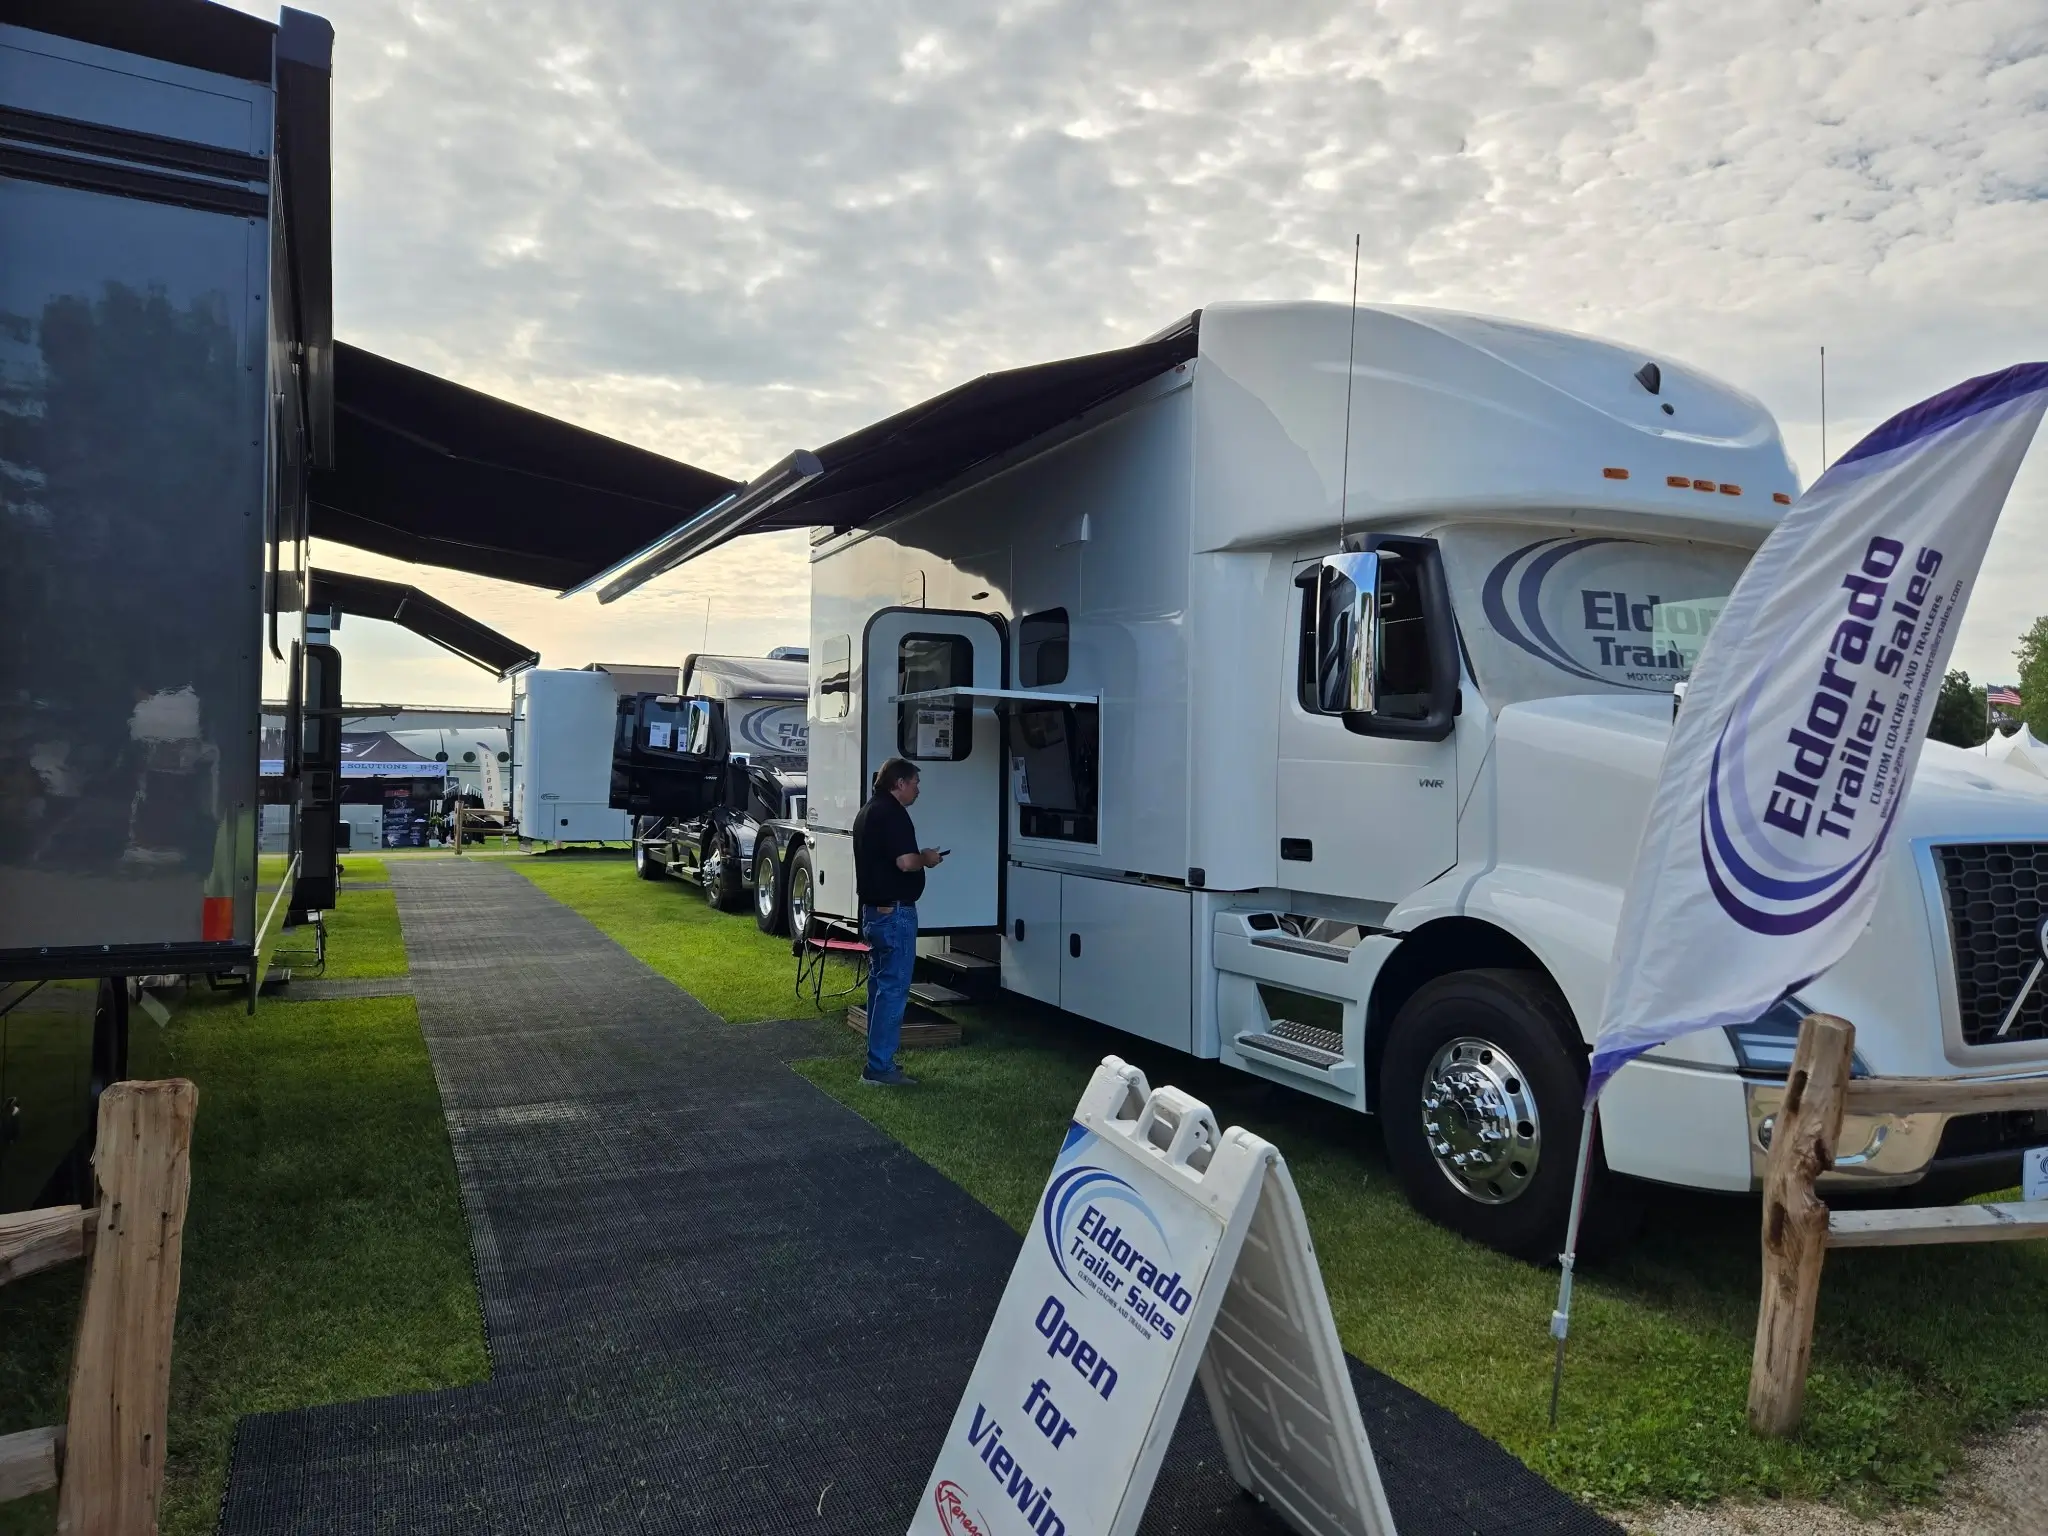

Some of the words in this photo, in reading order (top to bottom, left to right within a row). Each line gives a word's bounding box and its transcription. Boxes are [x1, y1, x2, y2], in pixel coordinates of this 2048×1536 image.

[1763, 536, 1904, 839] Eldorado
[1816, 690, 1886, 840] Trailer
[1874, 546, 1943, 678] Sales
[1870, 750, 1893, 805] CUSTOM
[1884, 691, 1909, 751] COACHES
[1901, 659, 1919, 691] AND
[1913, 594, 1944, 659] TRAILERS
[1418, 778, 1445, 789] VNR
[1070, 1235, 1124, 1293] Trailer
[1123, 1286, 1176, 1341] Sales
[1076, 1205, 1192, 1316] Eldorado
[1117, 1305, 1129, 1320] AND
[1034, 1294, 1119, 1401] Open
[1021, 1377, 1078, 1451] for
